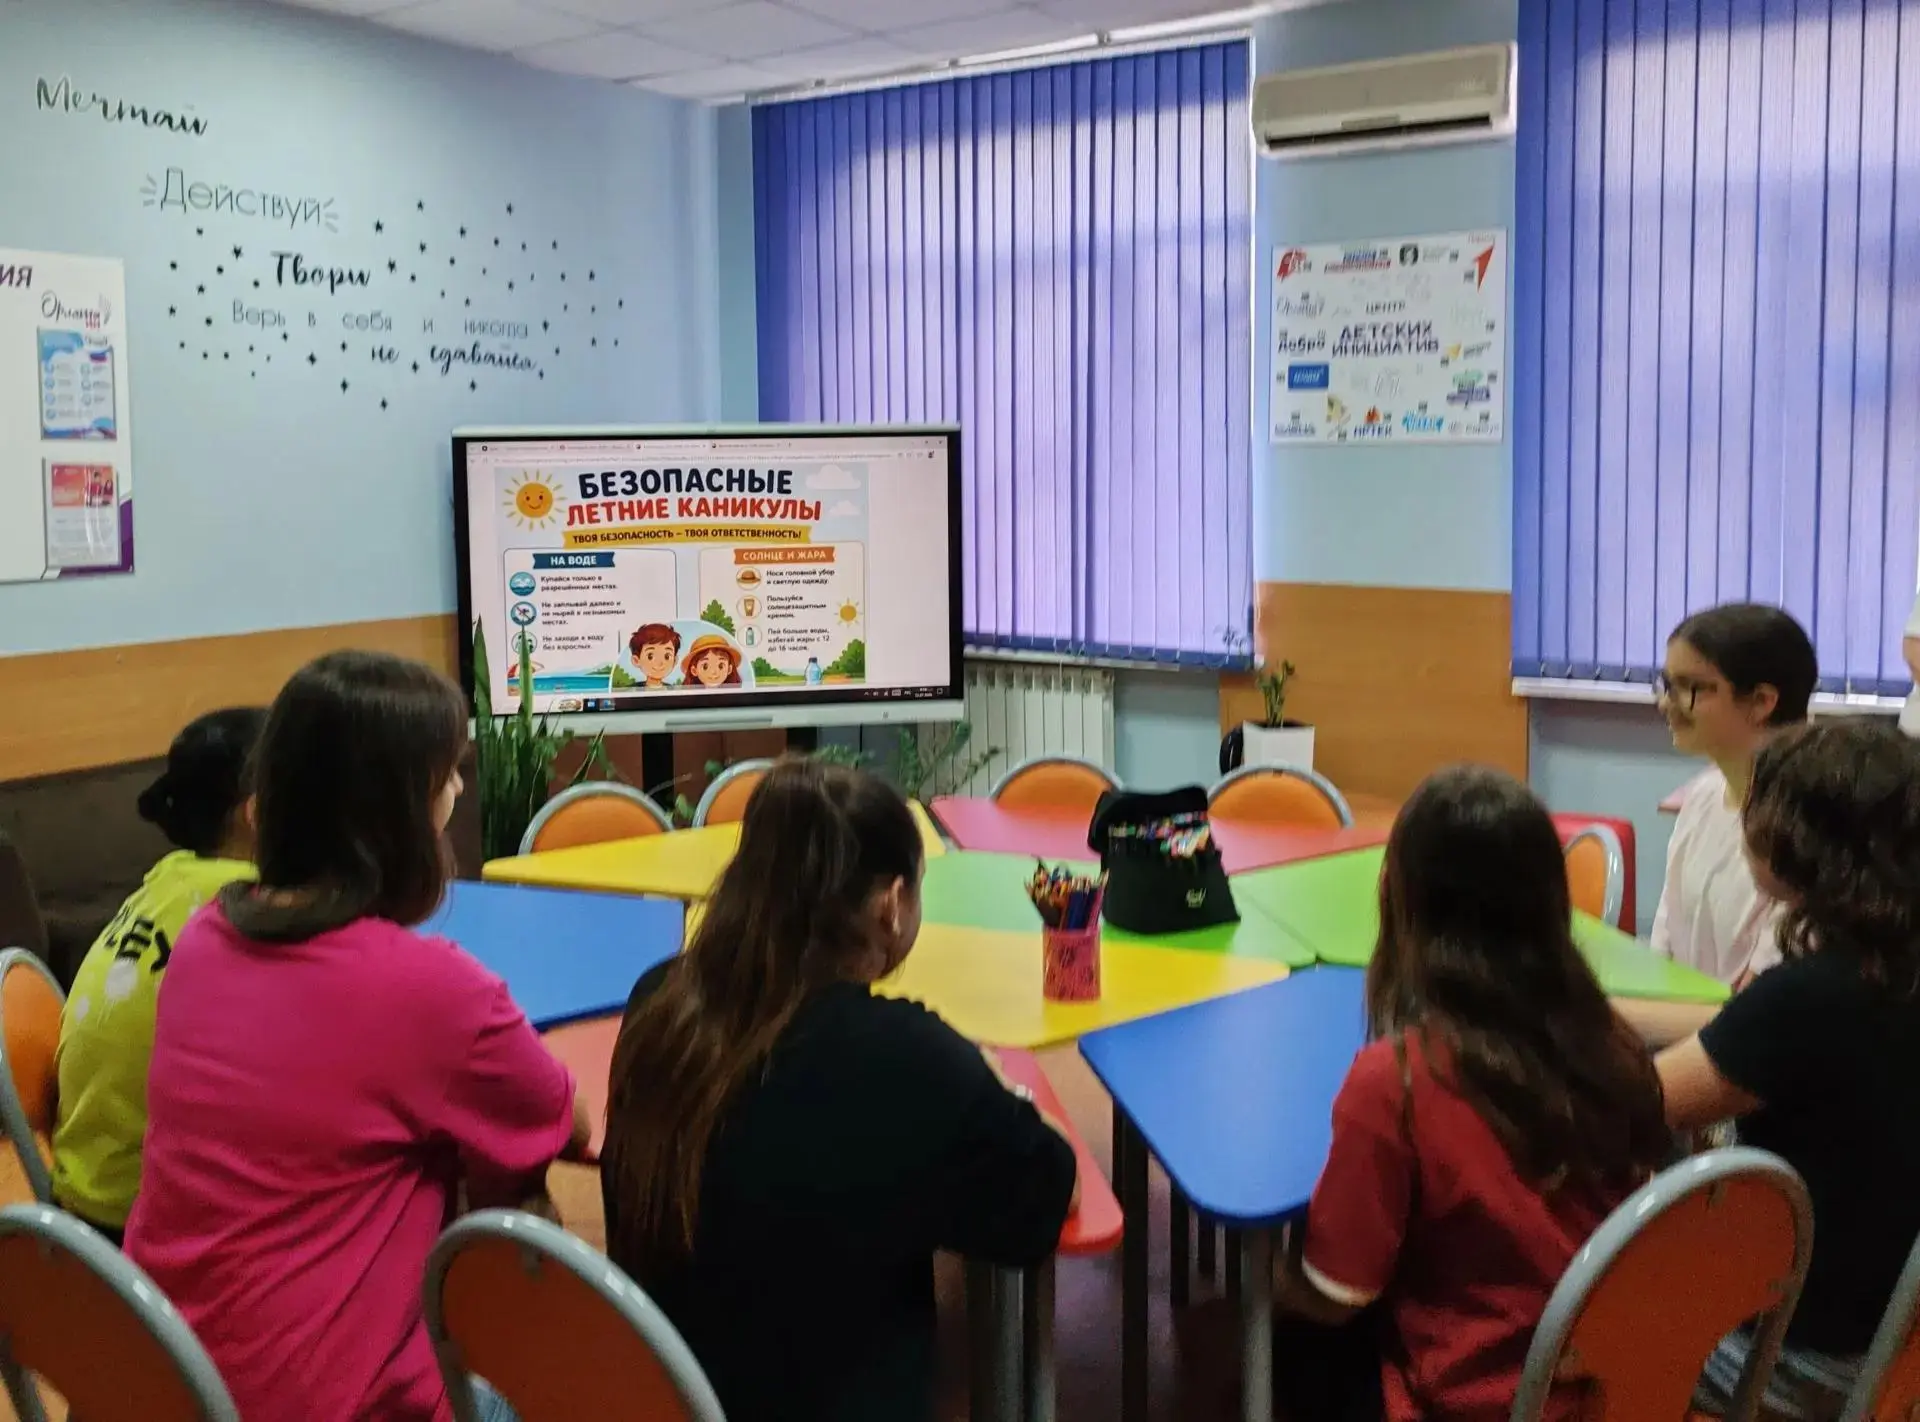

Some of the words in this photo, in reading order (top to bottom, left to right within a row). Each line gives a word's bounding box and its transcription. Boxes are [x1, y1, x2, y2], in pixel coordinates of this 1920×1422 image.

[36, 76, 207, 136] Мечтай
[160, 167, 320, 229] Действуй
[270, 250, 371, 295] Твори
[232, 299, 286, 331] Верь
[308, 311, 316, 327] в
[342, 310, 392, 332] себя
[423, 319, 433, 334] и
[1340, 320, 1432, 342] ДЕТСКИХ
[371, 345, 399, 363] не
[1332, 339, 1438, 358] ИНИЦИАТИВ
[578, 468, 793, 499] БЕЗОПАСНЫЕ
[567, 498, 669, 526] ЛЕТНИЕ
[677, 496, 821, 521] КАНИКУЛЫ
[573, 534, 598, 544] ТВОЯ
[600, 529, 674, 542] БЕЗОПАСНОСТЬ
[685, 528, 708, 538] ТВОЯ
[711, 528, 802, 539] ОТВЕТСТВЕННОСТЬ!
[550, 556, 566, 565] НА
[568, 555, 597, 566] ВОДЕ
[743, 551, 783, 561] СОЛНЦЕ
[787, 551, 795, 559] И
[797, 550, 826, 559] ЖАРА
[818, 568, 835, 577] убор
